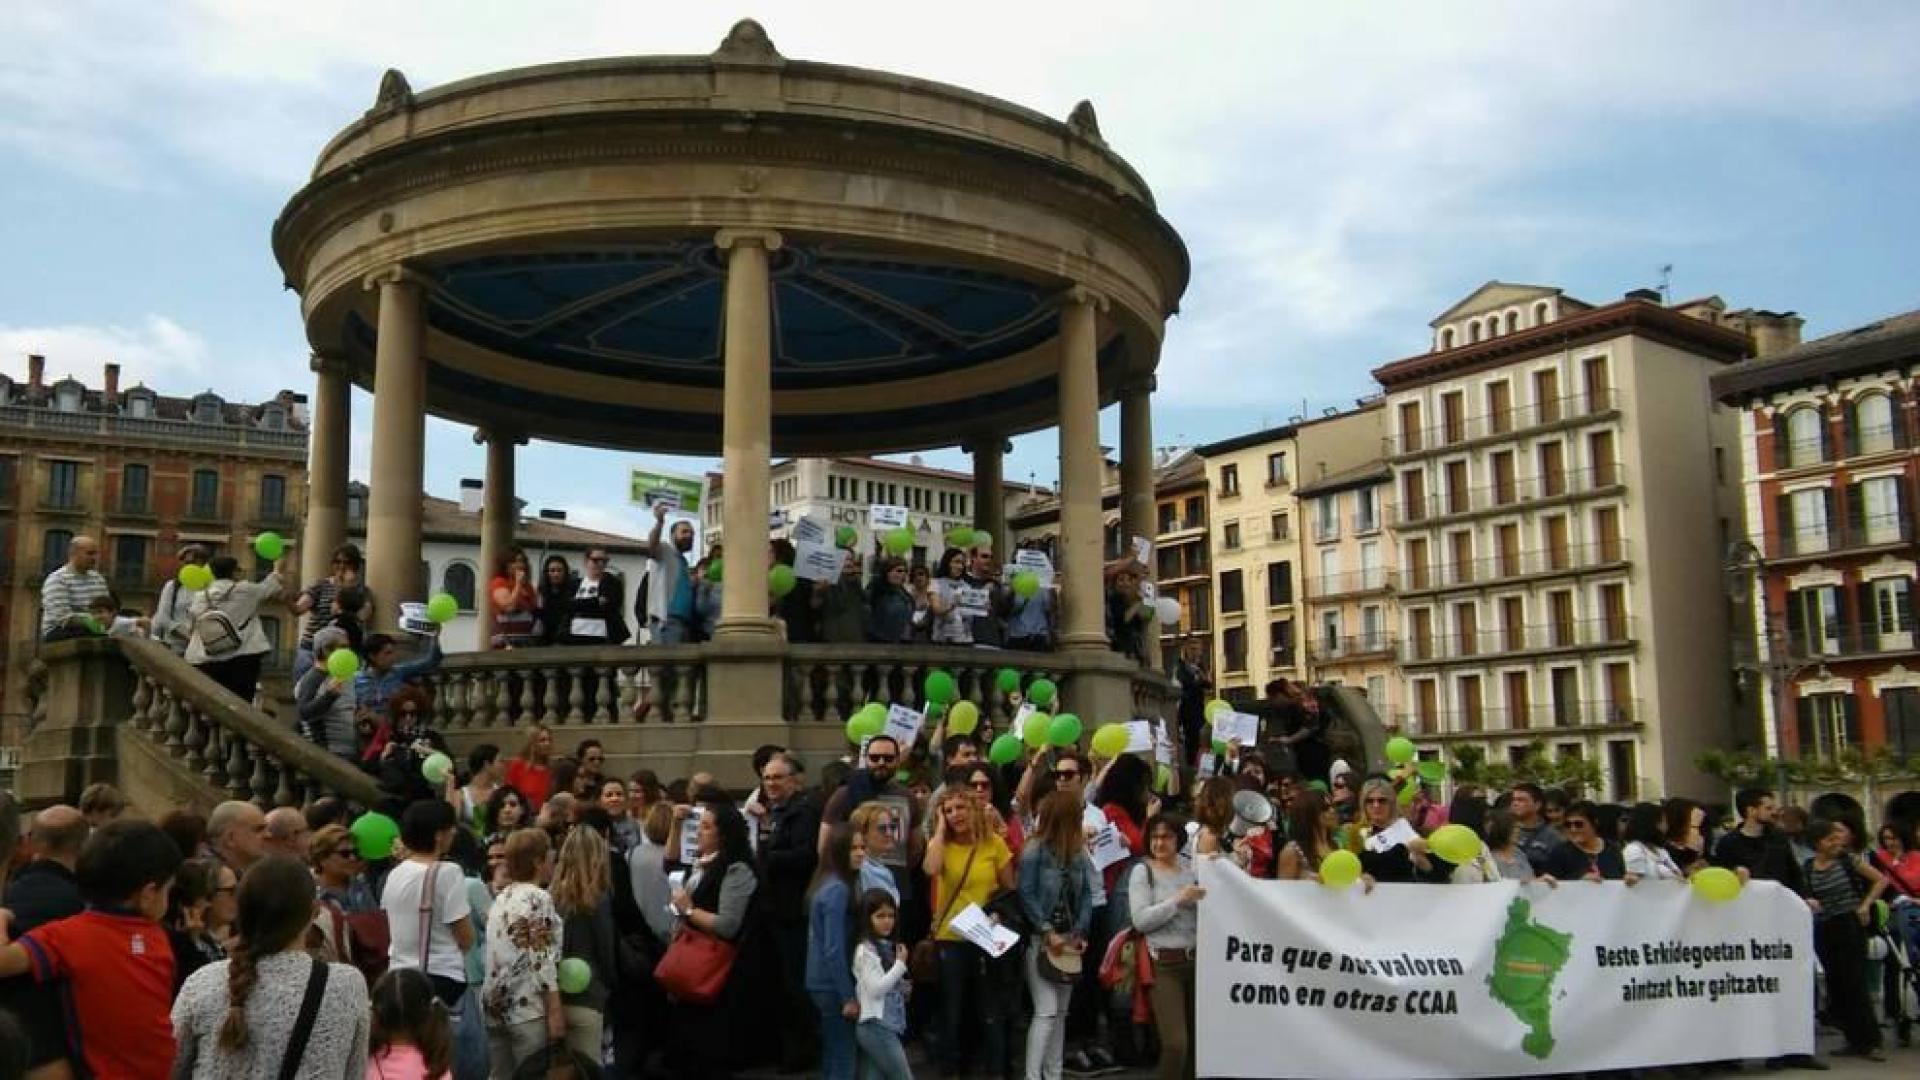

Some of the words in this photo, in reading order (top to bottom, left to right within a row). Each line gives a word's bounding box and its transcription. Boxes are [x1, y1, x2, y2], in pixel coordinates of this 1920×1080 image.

[1225, 936, 1274, 962] Para
[1281, 946, 1333, 973] que
[1378, 952, 1464, 977] valoren
[1595, 945, 1640, 968] Beste
[1641, 939, 1746, 969] Erkidegoetan
[1229, 982, 1290, 1005] como
[1296, 986, 1326, 1007] en
[1333, 988, 1399, 1013] otras
[1404, 989, 1458, 1015] CCAA
[1675, 974, 1706, 998] har
